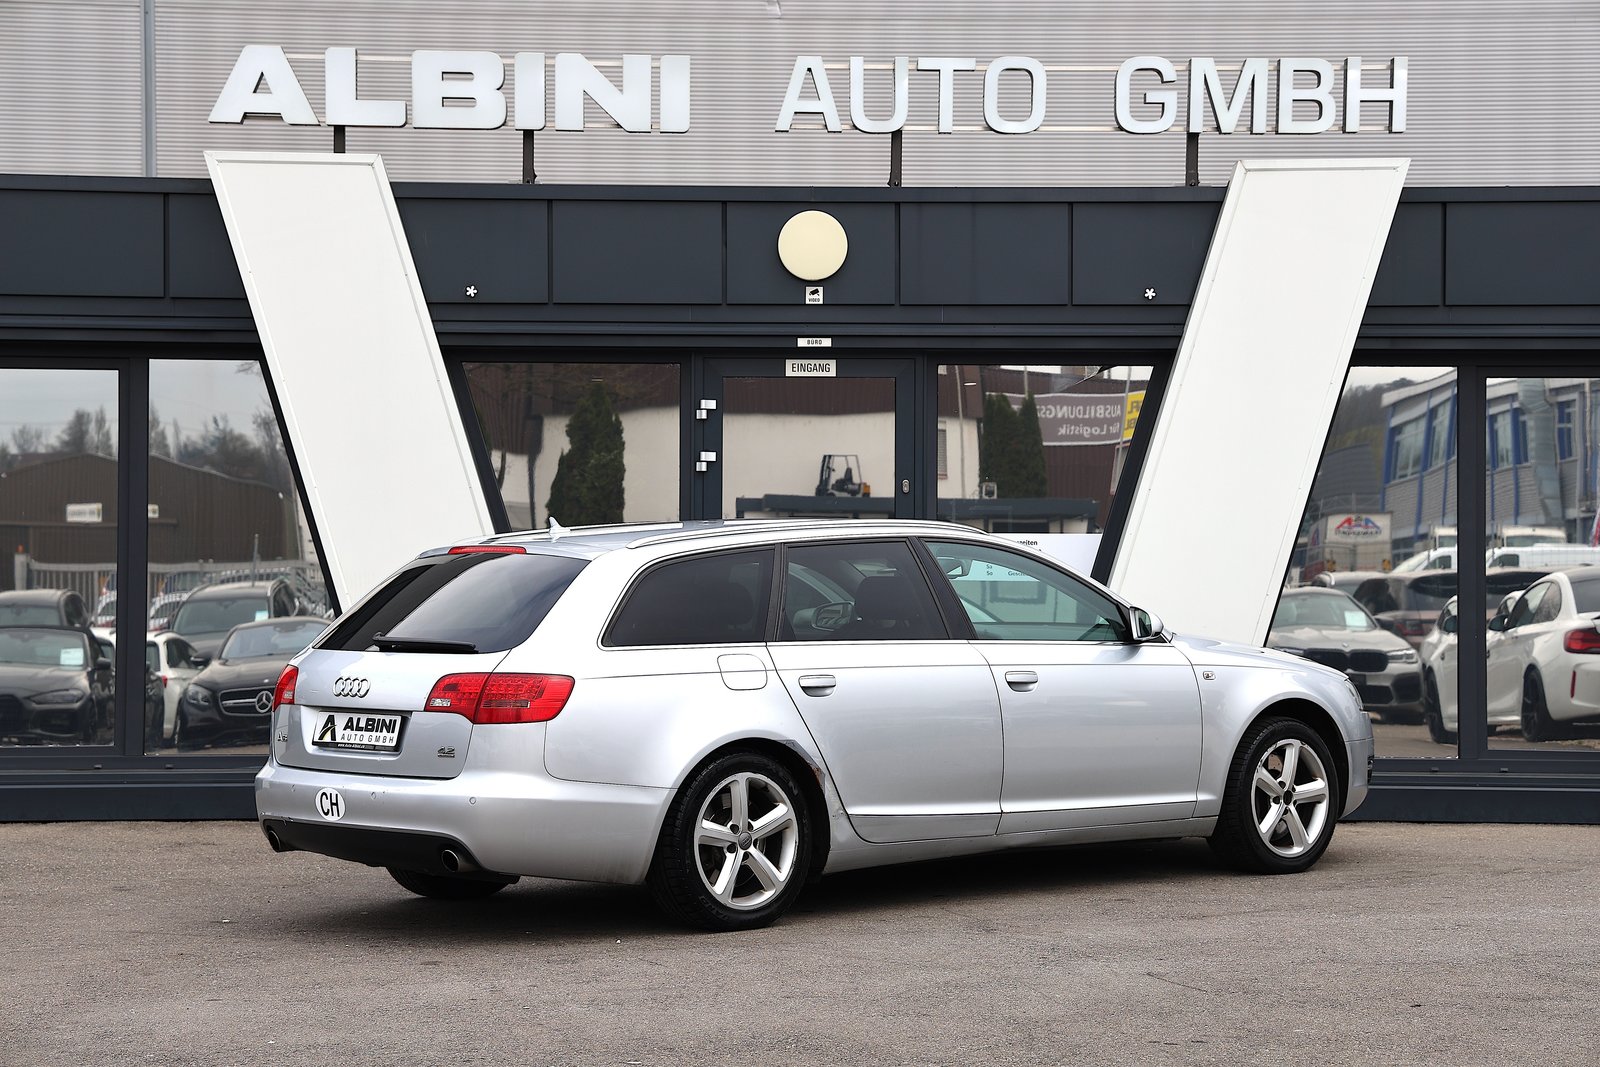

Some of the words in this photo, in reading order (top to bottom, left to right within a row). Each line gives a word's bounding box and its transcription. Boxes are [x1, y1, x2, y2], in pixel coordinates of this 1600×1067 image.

[208, 44, 691, 133] ALBINI
[775, 55, 1048, 134] AUTO
[1114, 55, 1409, 135] GMBH
[807, 338, 822, 346] BÜRO
[791, 362, 831, 373] EINGANG
[343, 716, 398, 733] ALBINI
[340, 733, 365, 742] AUTO
[367, 734, 395, 743] GMBH
[320, 792, 340, 817] CH
